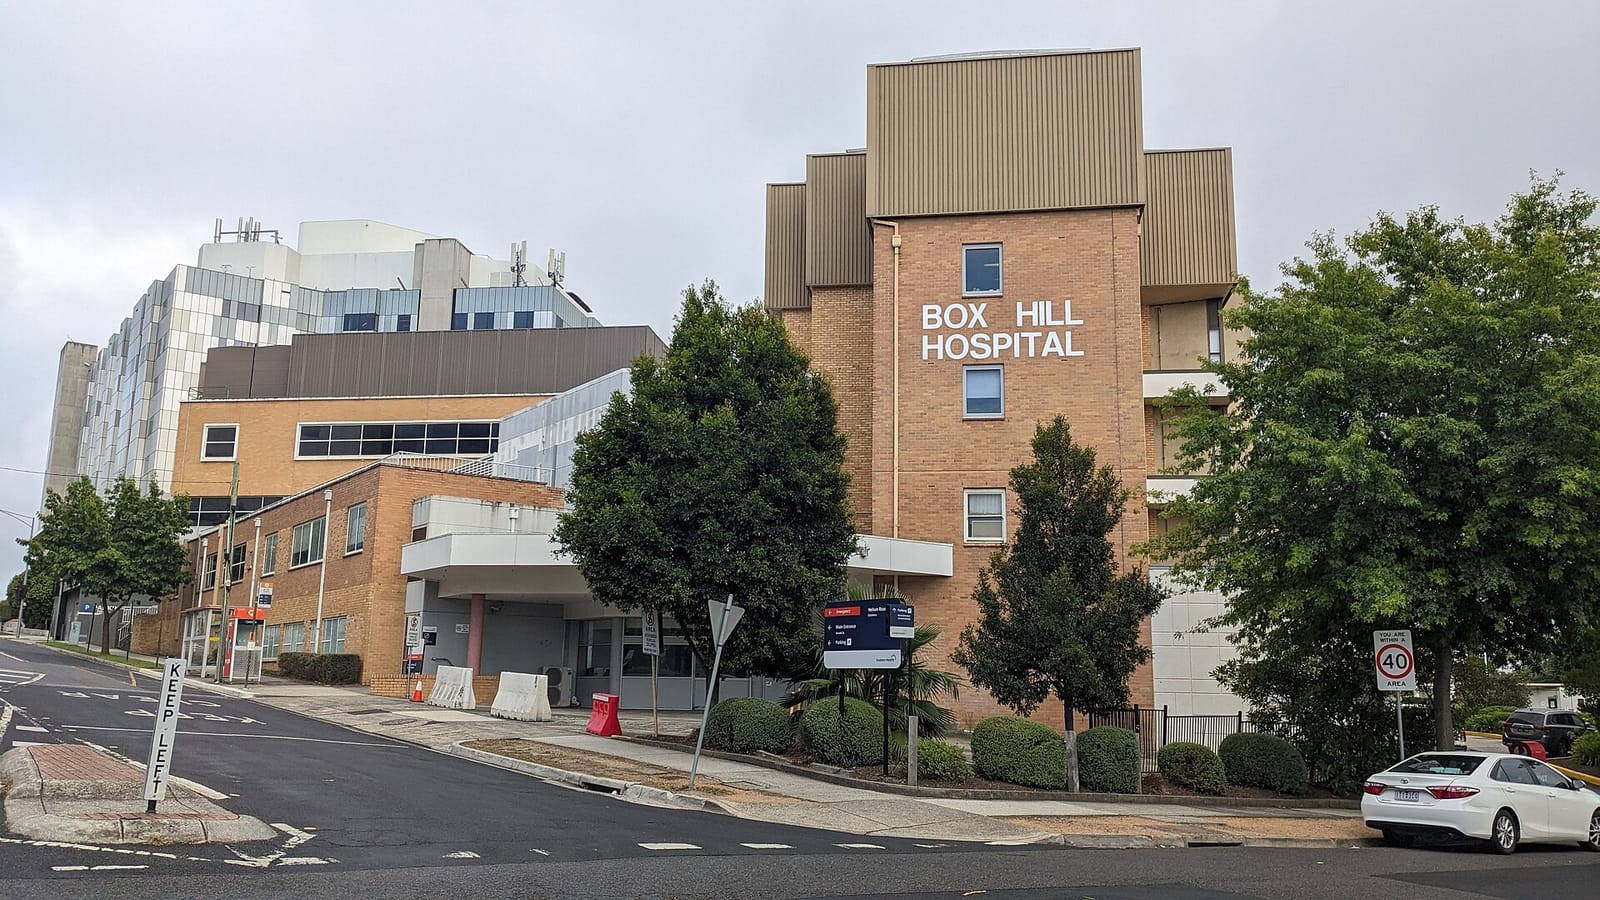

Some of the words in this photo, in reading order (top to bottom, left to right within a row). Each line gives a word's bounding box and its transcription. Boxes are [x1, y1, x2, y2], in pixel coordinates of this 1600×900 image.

[922, 303, 988, 330] BOX
[1016, 299, 1084, 327] HILL
[921, 330, 1085, 360] HOSPITAL
[1382, 653, 1408, 670] 40
[162, 663, 181, 723] KEEP
[152, 733, 169, 794] LEFT
